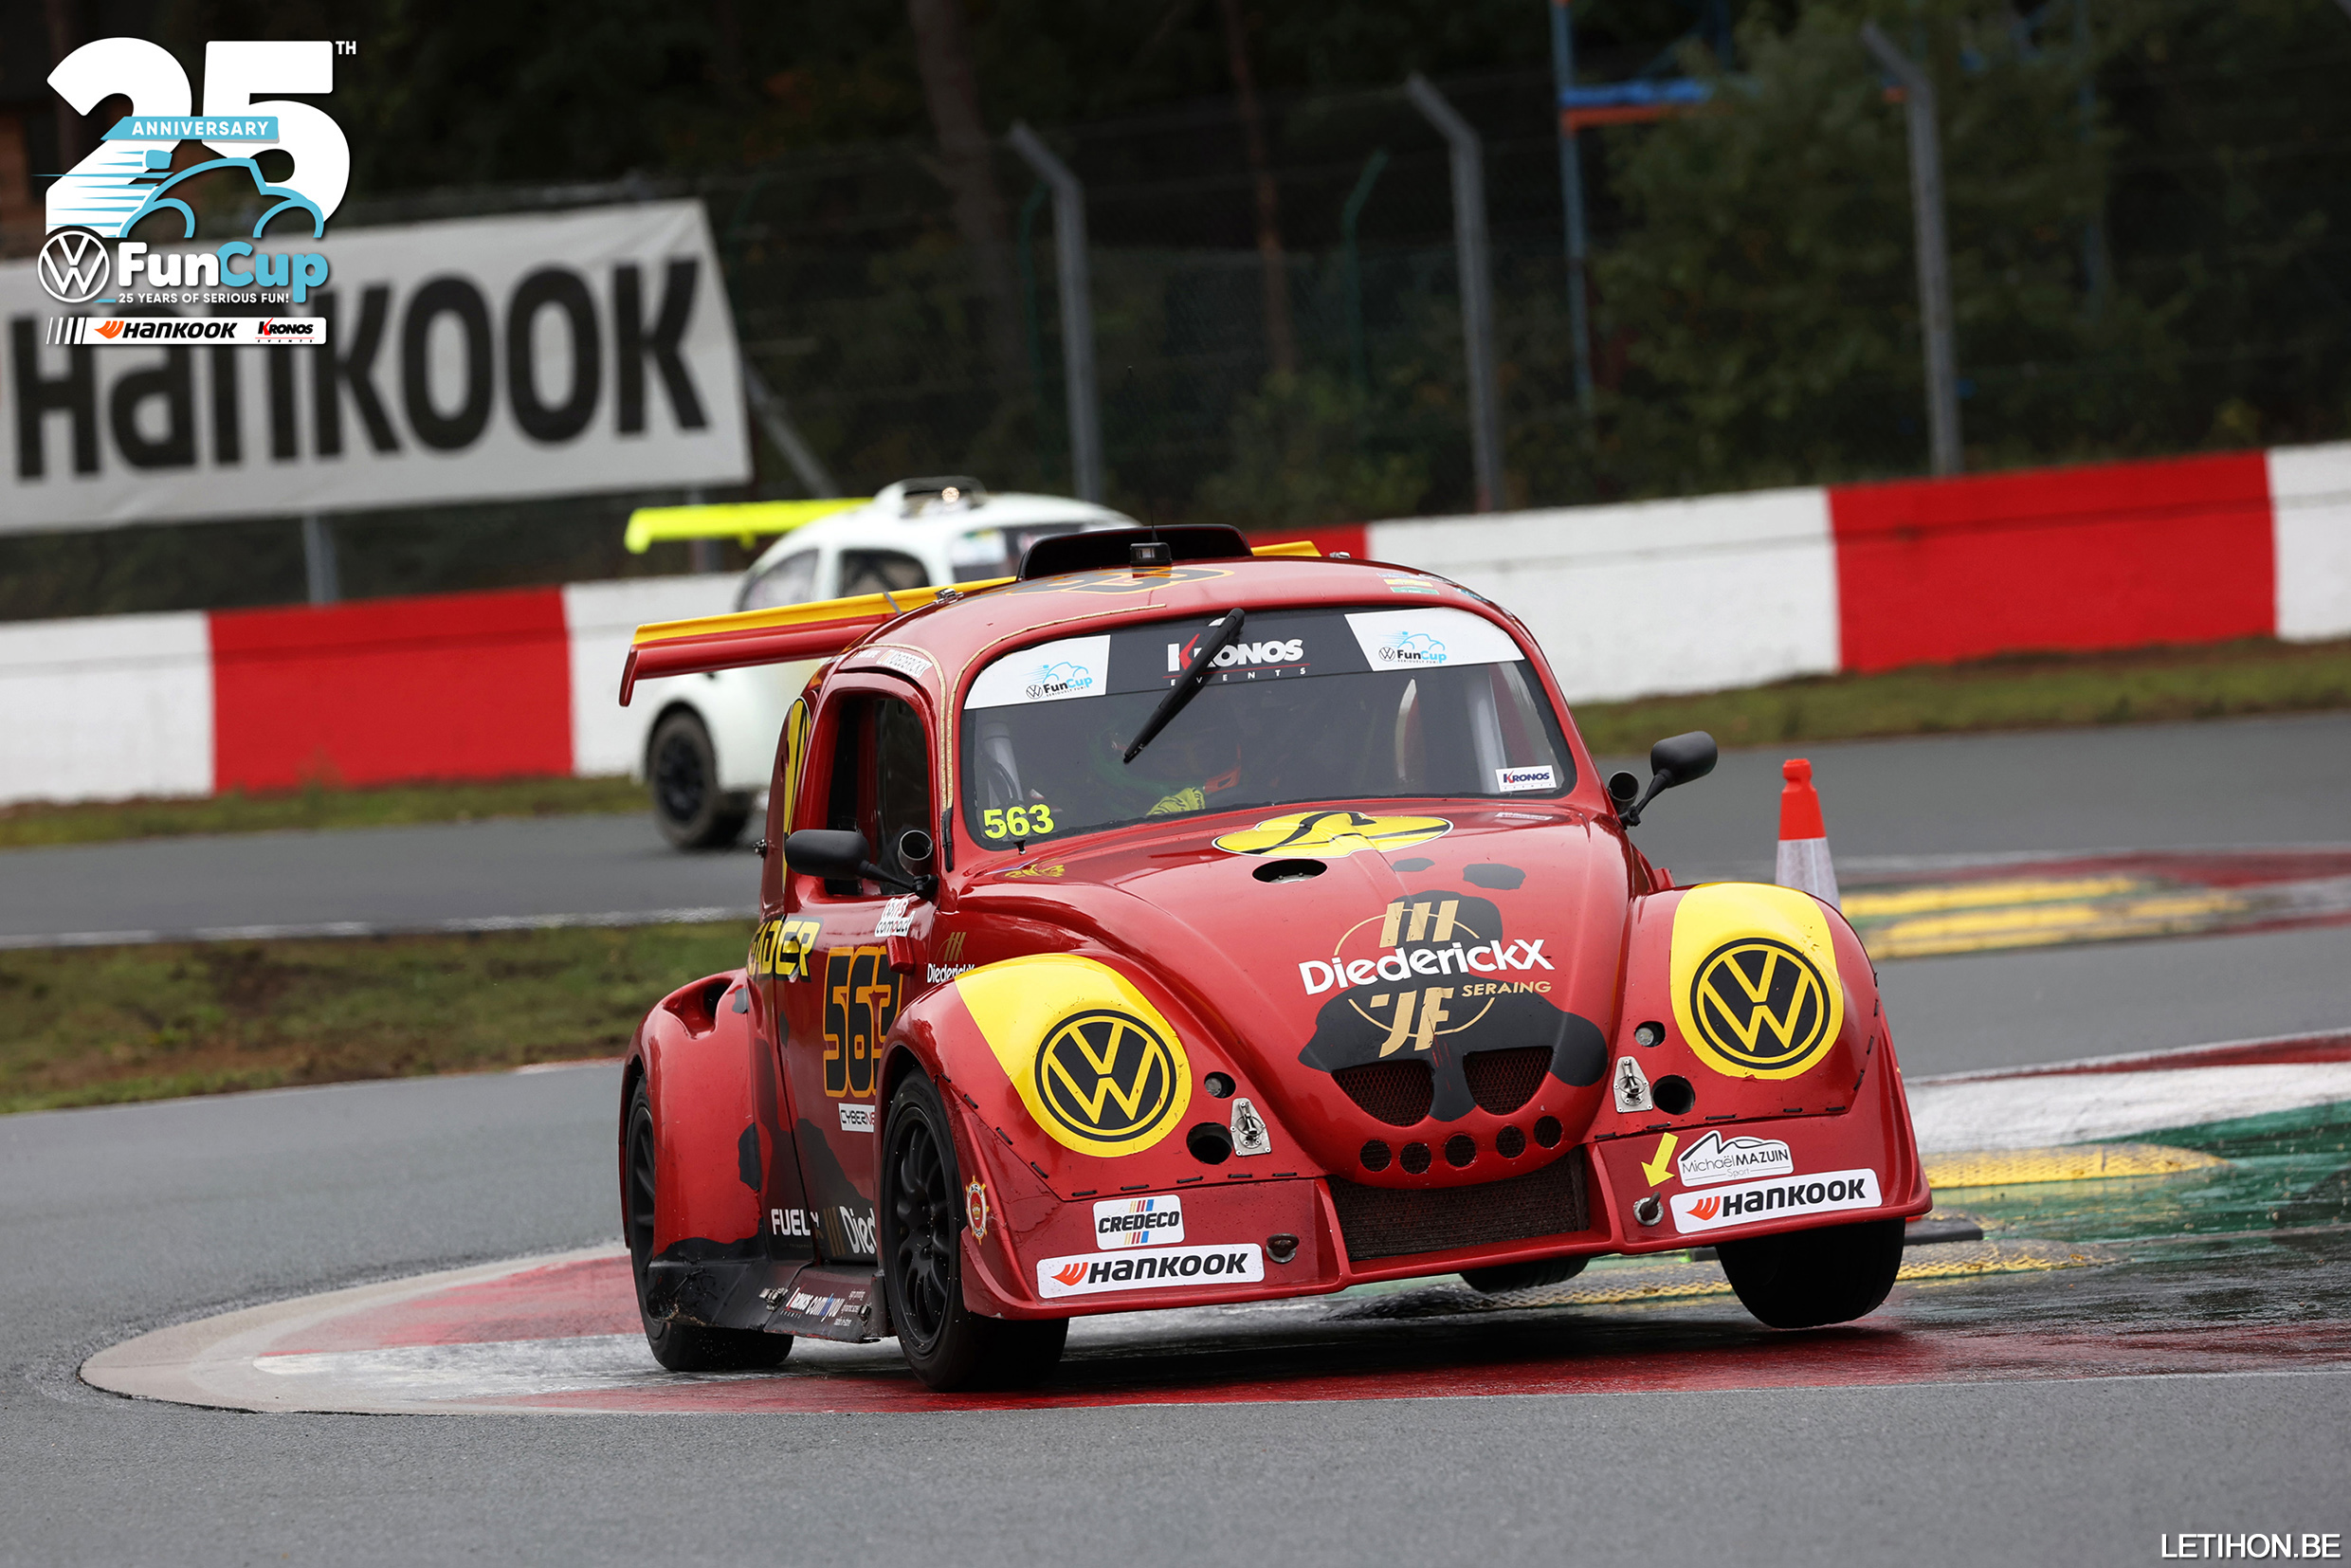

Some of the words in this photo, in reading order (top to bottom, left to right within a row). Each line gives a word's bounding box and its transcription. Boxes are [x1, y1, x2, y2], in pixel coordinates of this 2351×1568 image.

[1167, 633, 1304, 672] KONOS
[1396, 649, 1447, 664] FunCup
[1170, 667, 1306, 686] EVENTS
[1043, 677, 1093, 694] FunCup
[1503, 769, 1550, 784] KRONOS
[983, 803, 1054, 839] 563
[1461, 980, 1552, 997] SERAING
[1726, 1167, 1750, 1178] Sport
[1098, 1211, 1180, 1234] CREDECO
